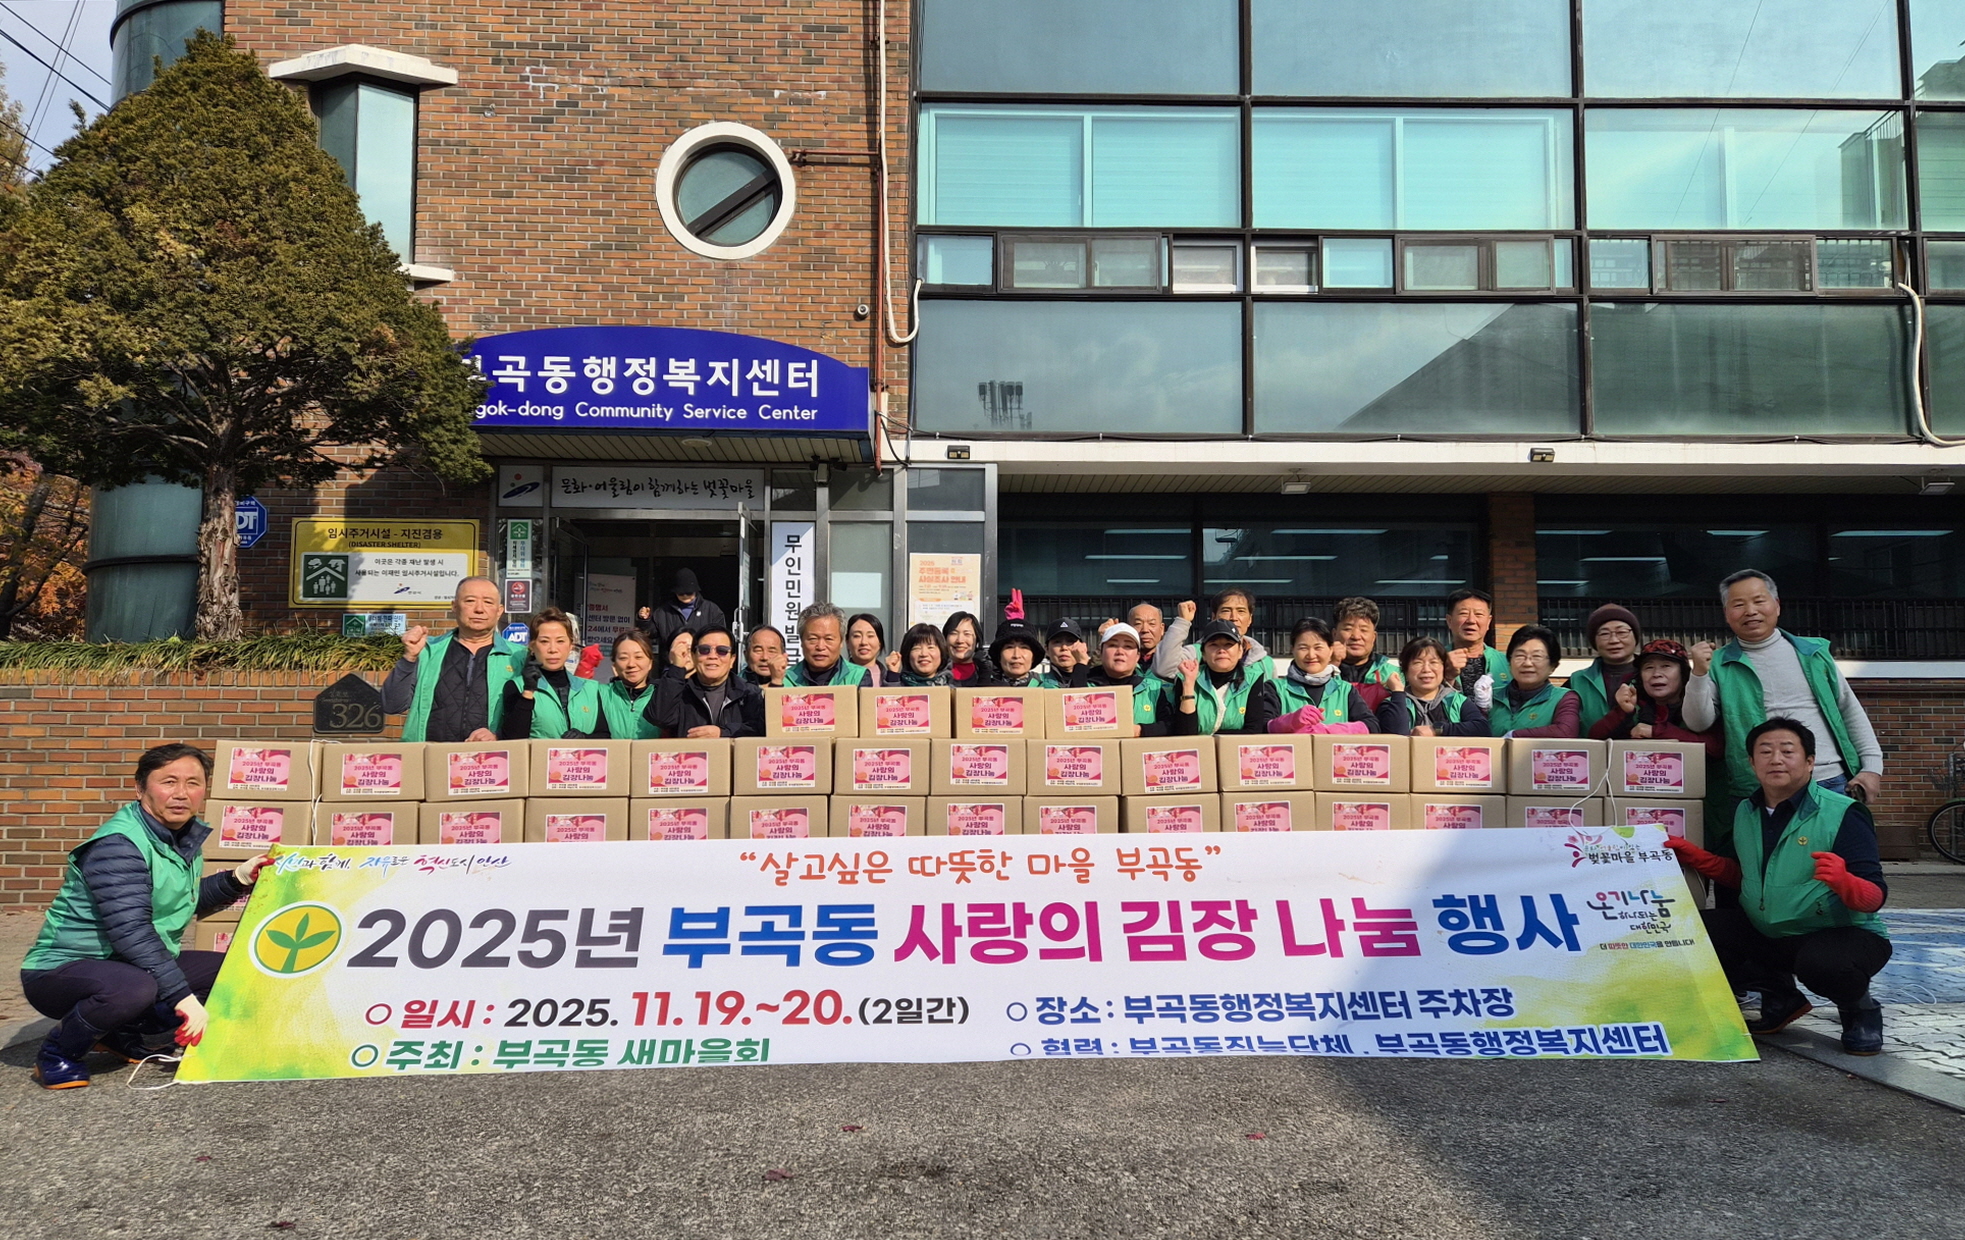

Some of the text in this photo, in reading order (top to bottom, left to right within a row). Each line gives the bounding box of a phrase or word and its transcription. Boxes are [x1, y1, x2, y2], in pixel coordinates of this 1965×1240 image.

[475, 400, 818, 421] gok-dong Community Service Center
[703, 478, 755, 499] 벚꽃마을
[235, 511, 258, 530] DT
[327, 528, 391, 540] 임시주거시설
[400, 528, 443, 541] 지진겸용
[507, 632, 528, 642] ADT
[329, 703, 382, 729] 326
[245, 774, 277, 782] 김장나눔
[250, 766, 274, 774] 사랑의
[1159, 775, 1188, 783] 김장나눔
[1347, 768, 1376, 776] 김장나눔
[236, 831, 269, 840] 김장나눔
[358, 855, 411, 878] 자유로운
[413, 854, 475, 875] 혁신도시
[476, 855, 513, 868] 안산
[908, 847, 1013, 885] 따뜻한
[1026, 847, 1095, 884] 마을
[1588, 848, 1673, 865] 벚꽃마을 부곡동
[1586, 889, 1676, 920] 온기나눔
[1618, 911, 1658, 921] 하나되는
[346, 906, 645, 969] 2025년
[662, 903, 879, 969] 부곡동
[893, 900, 1102, 964] 사랑의
[1431, 893, 1582, 956] 행사
[1630, 921, 1671, 934] 대한민국
[503, 998, 619, 1029] 2025.
[1123, 990, 1412, 1024] 부곡동행정복지센터
[1416, 987, 1516, 1019] 주차장
[1375, 1024, 1669, 1054] 부곡동행정복지센터
[492, 1038, 610, 1068] 부곡동
[616, 1037, 770, 1066] 새마을회
